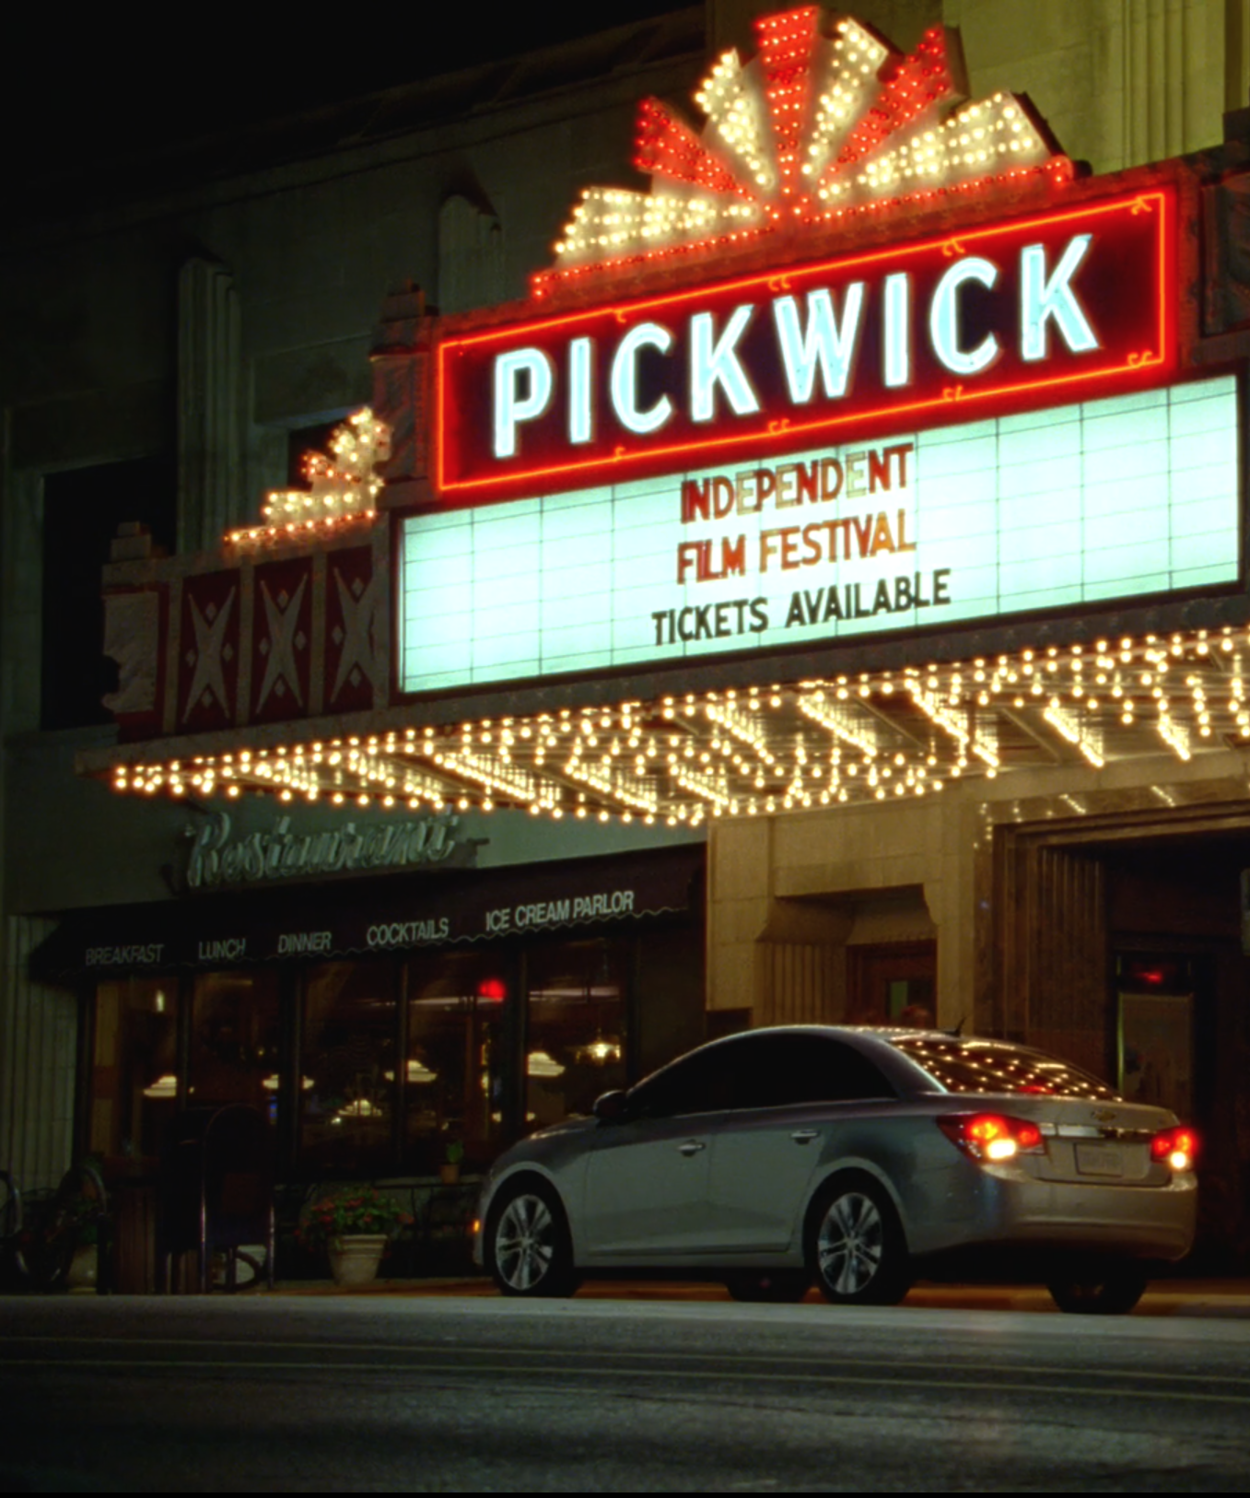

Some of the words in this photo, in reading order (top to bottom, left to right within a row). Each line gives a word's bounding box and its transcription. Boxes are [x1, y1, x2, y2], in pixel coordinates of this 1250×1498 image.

[493, 234, 1099, 459] PICKWICK
[680, 442, 914, 525] INDEPENDENT
[676, 533, 746, 585] FILM
[759, 508, 917, 574] FESTIVAL
[651, 596, 769, 646] TICKETS
[785, 568, 951, 629] AVAILABLE
[184, 810, 460, 888] Restaurant
[85, 943, 164, 967] BREAKFAST
[198, 937, 247, 961] LUNCH
[277, 930, 333, 954] DINNER
[366, 917, 450, 946] COCKTAILS
[485, 907, 512, 932] ICE
[514, 899, 571, 927] CREAM
[572, 889, 635, 919] PARLOR
